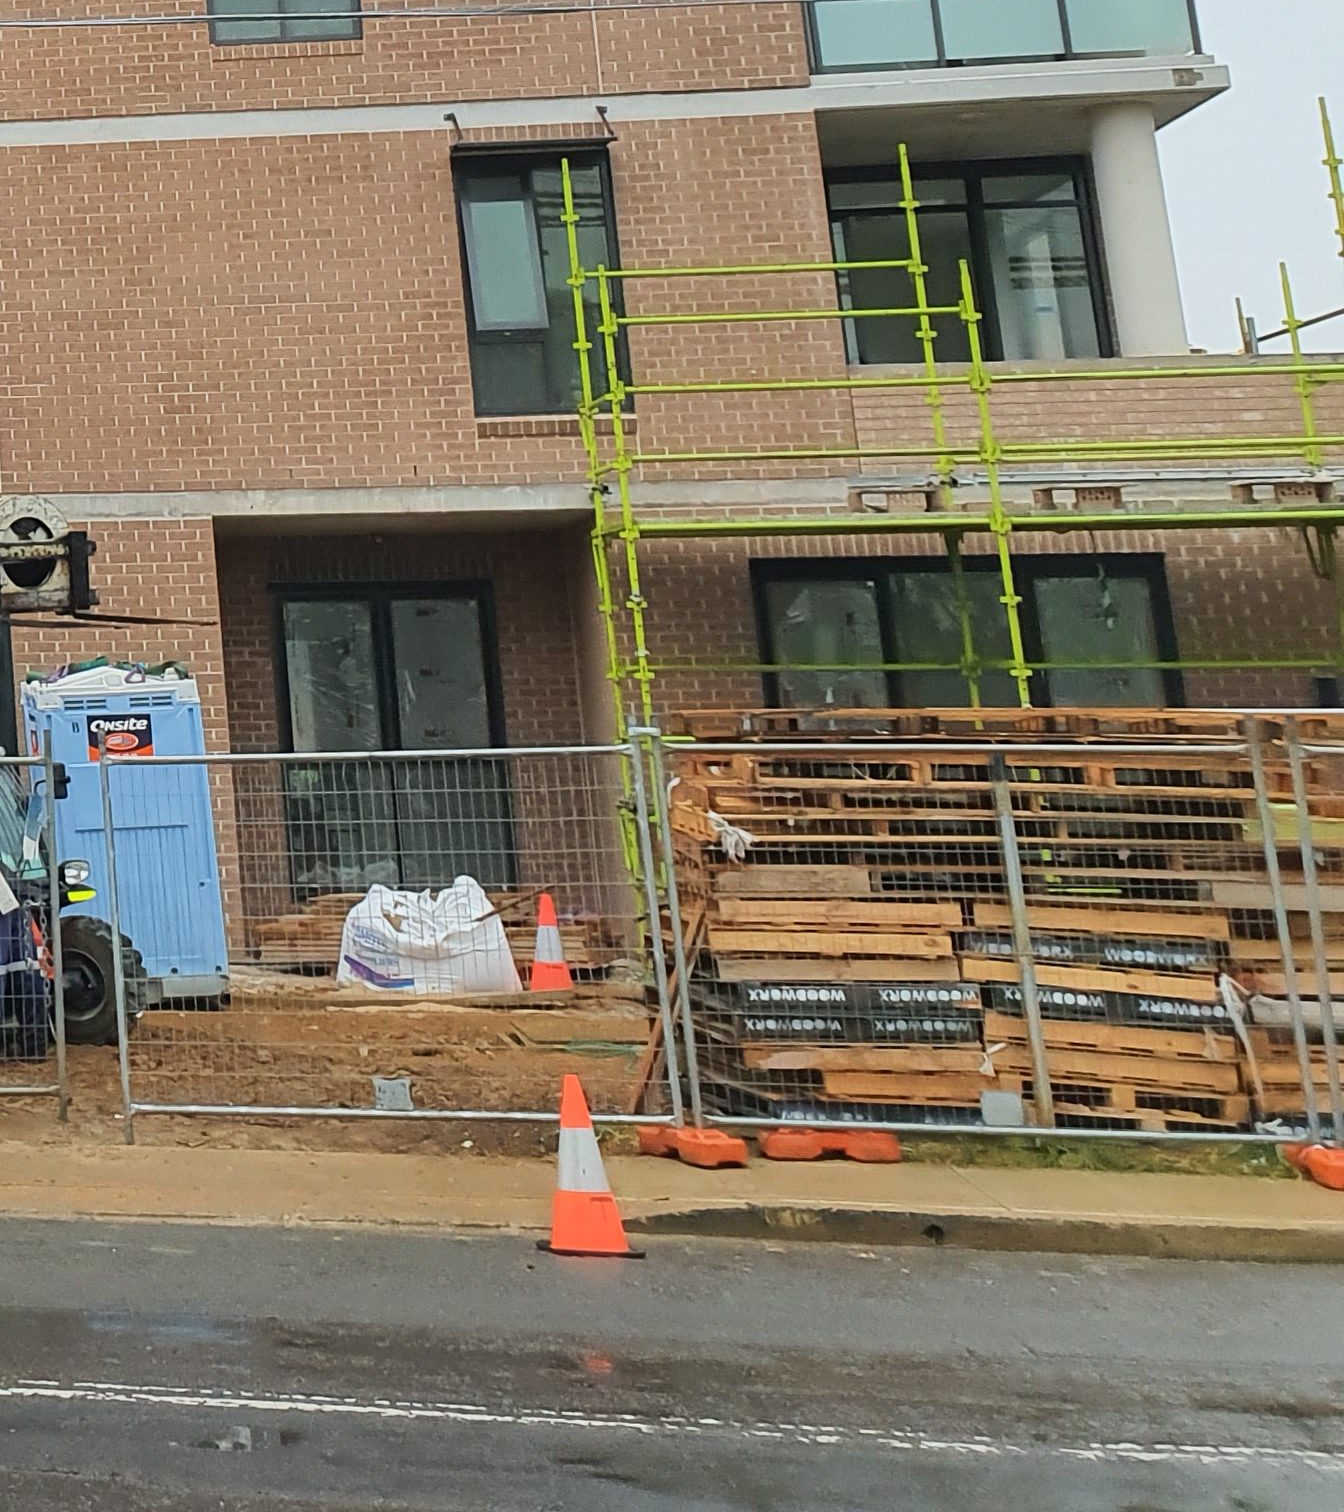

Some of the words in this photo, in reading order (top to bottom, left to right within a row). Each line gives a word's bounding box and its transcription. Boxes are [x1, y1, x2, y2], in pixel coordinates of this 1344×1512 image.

[749, 988, 846, 1002] WOODWORX
[879, 989, 978, 1002] WOODWORX
[1004, 988, 1105, 1008] WOODWRX
[1138, 999, 1232, 1018] OODWORX
